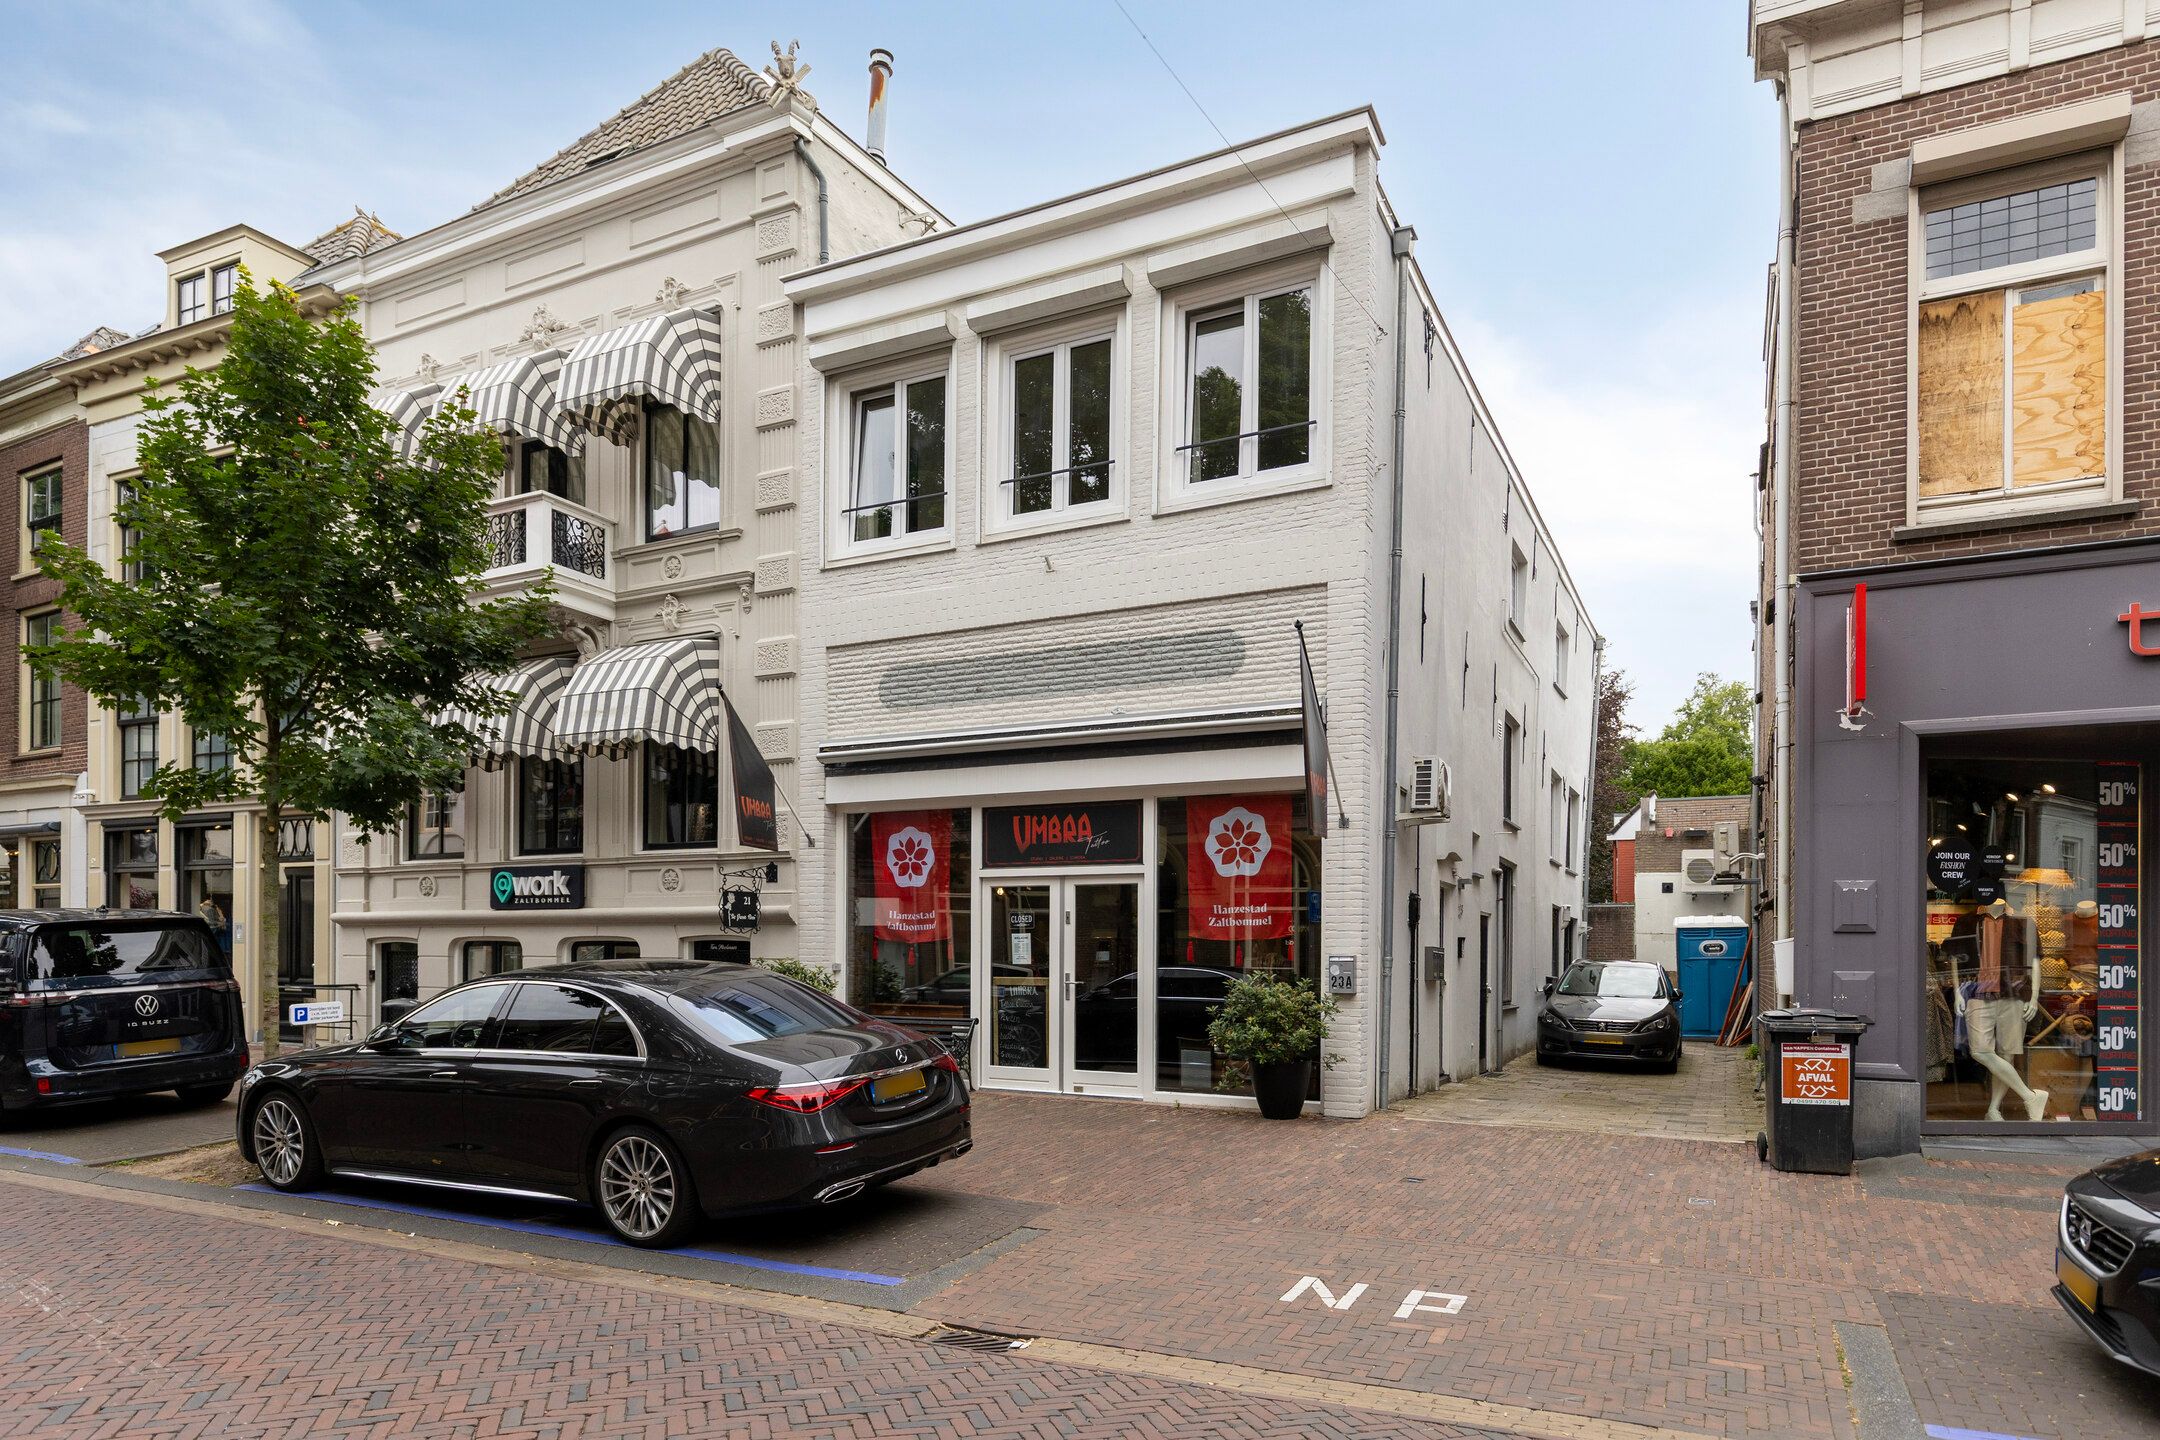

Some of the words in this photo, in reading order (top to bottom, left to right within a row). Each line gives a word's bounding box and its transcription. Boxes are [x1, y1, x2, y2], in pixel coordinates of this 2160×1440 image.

[2099, 781, 2137, 806] 50%
[1013, 813, 1093, 854] UMBRA
[1935, 852, 1953, 860] JOIN
[1954, 852, 1970, 860] OUR
[2099, 843, 2137, 867] 50%
[1940, 861, 1966, 869] FASHION
[1941, 871, 1964, 879] CREW
[743, 896, 751, 905] 21
[1213, 903, 1267, 914] Hanzestad
[889, 910, 935, 920] Hanzestad
[1010, 915, 1033, 923] CLOSED
[1208, 915, 1272, 927] Zaltbommel
[2099, 904, 2137, 928] 50%
[1331, 975, 1352, 989] 23A
[2099, 965, 2137, 989] 50%
[2099, 1026, 2137, 1050] 50%
[1797, 1073, 1833, 1083] AFVAL
[2099, 1087, 2137, 1111] 50%
